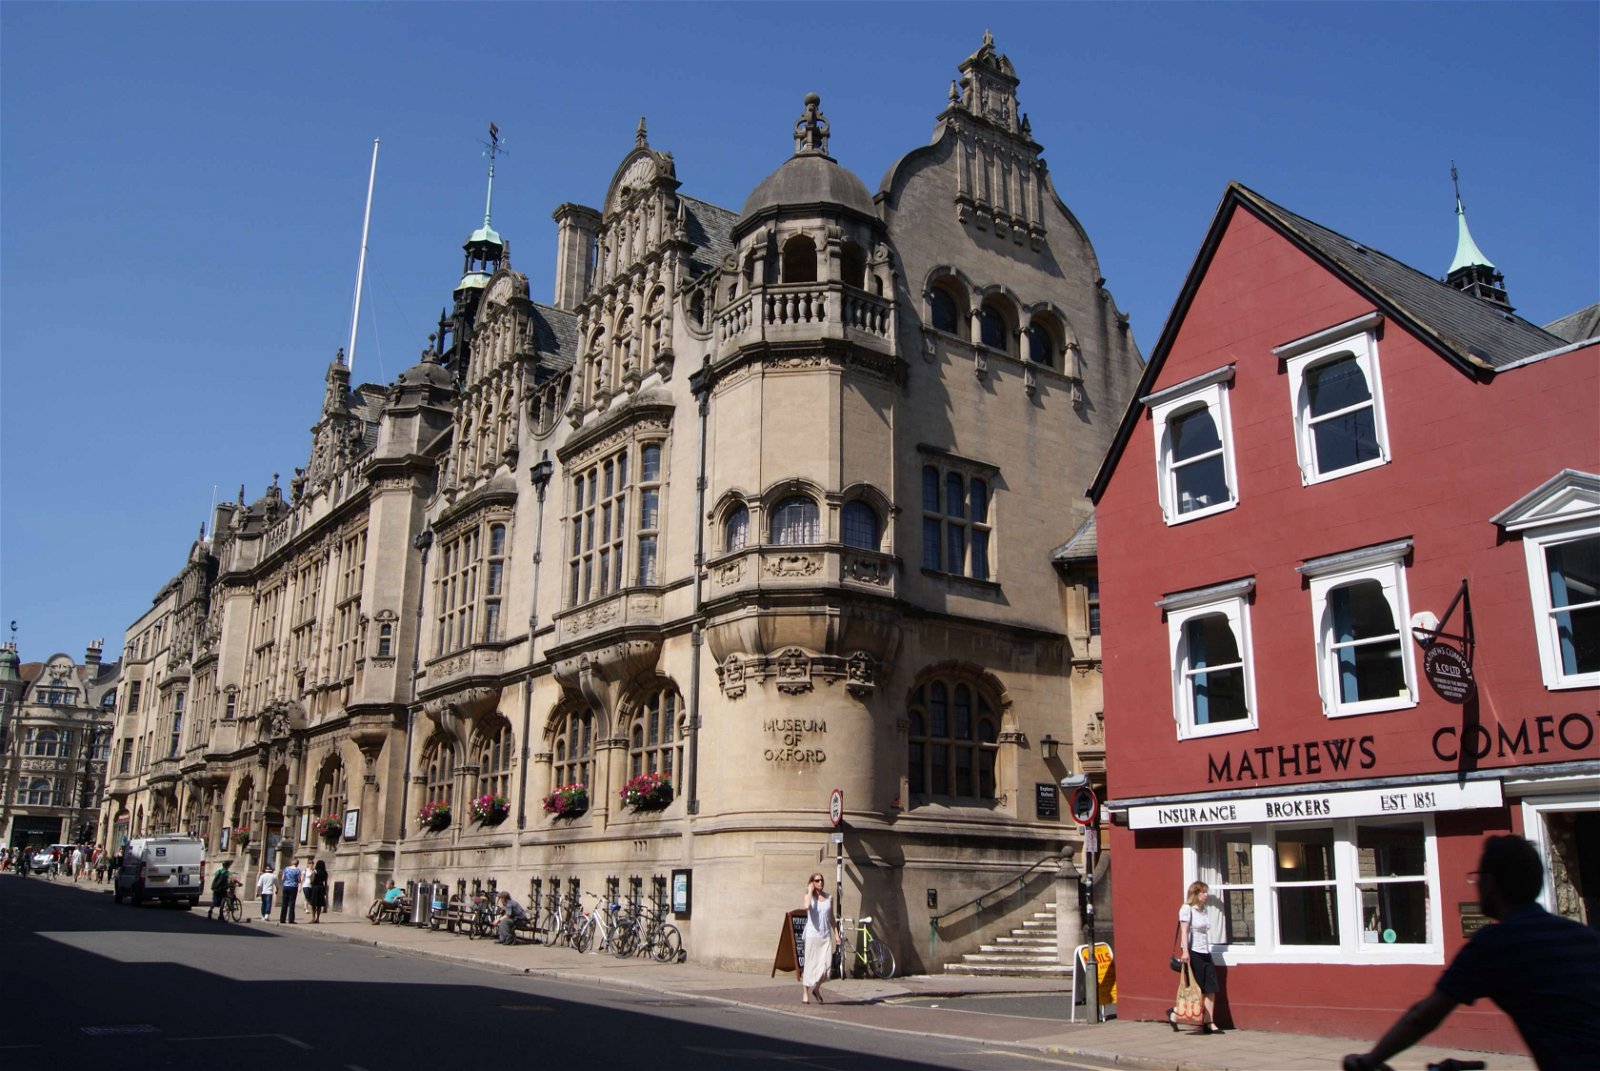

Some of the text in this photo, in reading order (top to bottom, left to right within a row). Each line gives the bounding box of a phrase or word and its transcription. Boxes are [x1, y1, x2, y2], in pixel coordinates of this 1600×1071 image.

[1449, 665, 1461, 676] LTD
[763, 718, 827, 733] MUSEUM
[784, 734, 802, 746] OF
[1207, 710, 1600, 783] MATHEWS COMFO
[764, 749, 826, 763] OXFORD
[1158, 791, 1437, 824] INSURANCE BROKERS EST 1851
